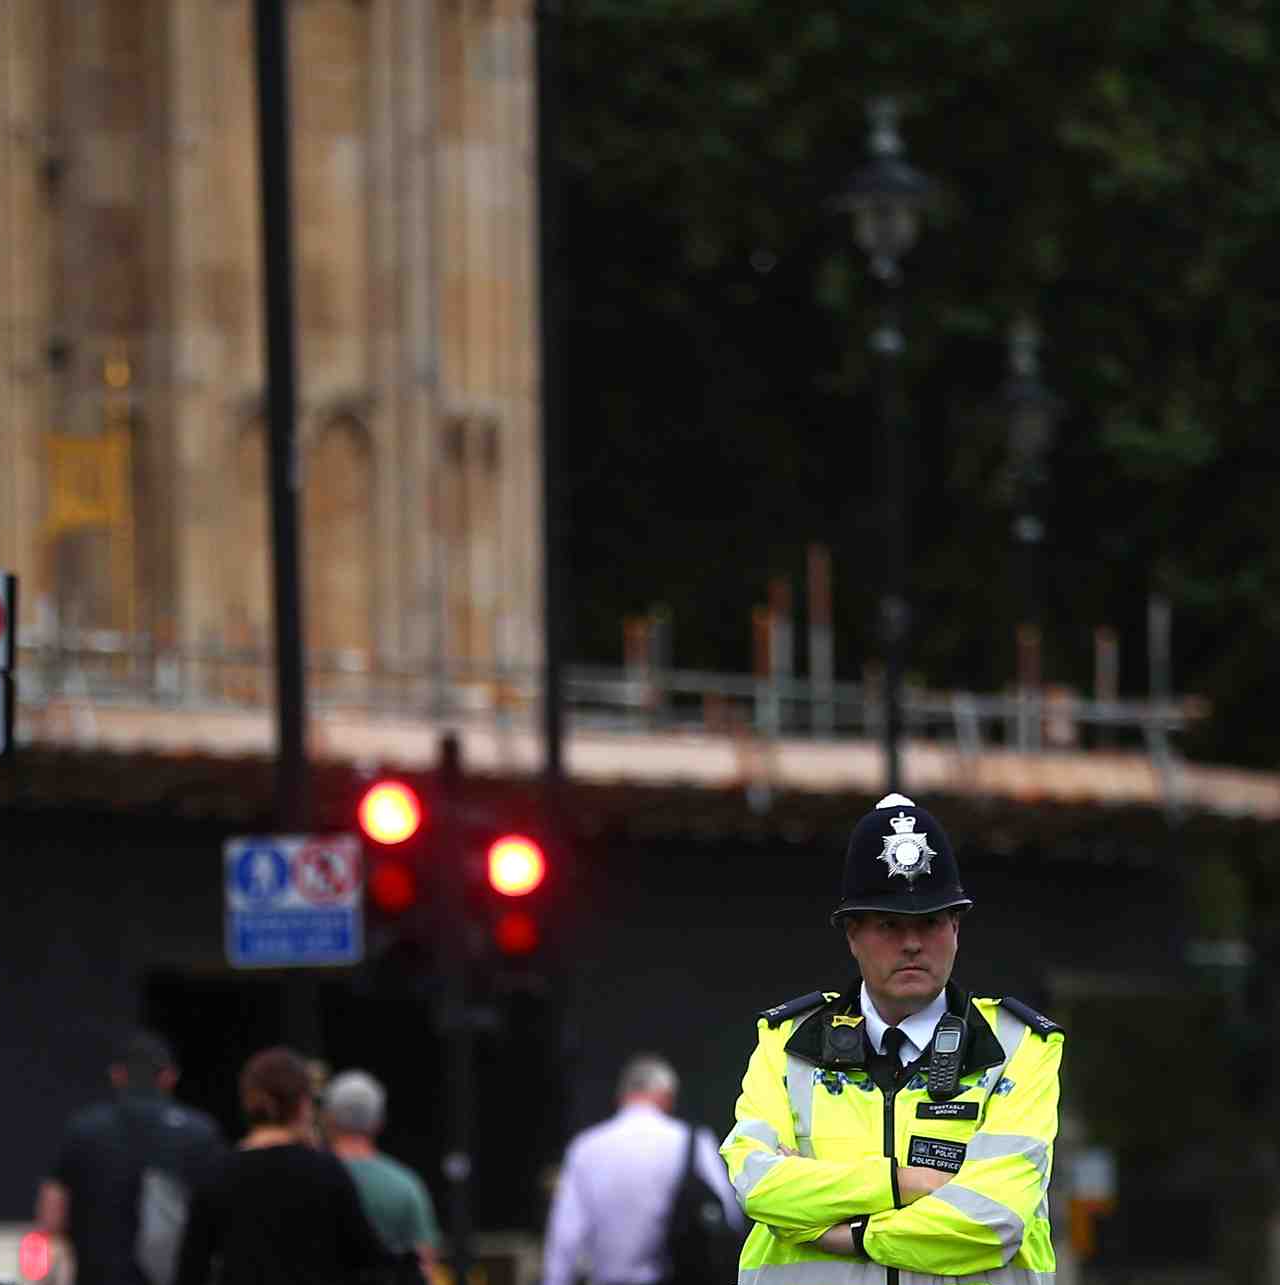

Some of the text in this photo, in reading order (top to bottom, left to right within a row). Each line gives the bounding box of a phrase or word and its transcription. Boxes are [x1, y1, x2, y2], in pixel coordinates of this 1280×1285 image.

[935, 1149, 958, 1159] POLICE
[911, 1156, 960, 1169] POLICE OFFICE
